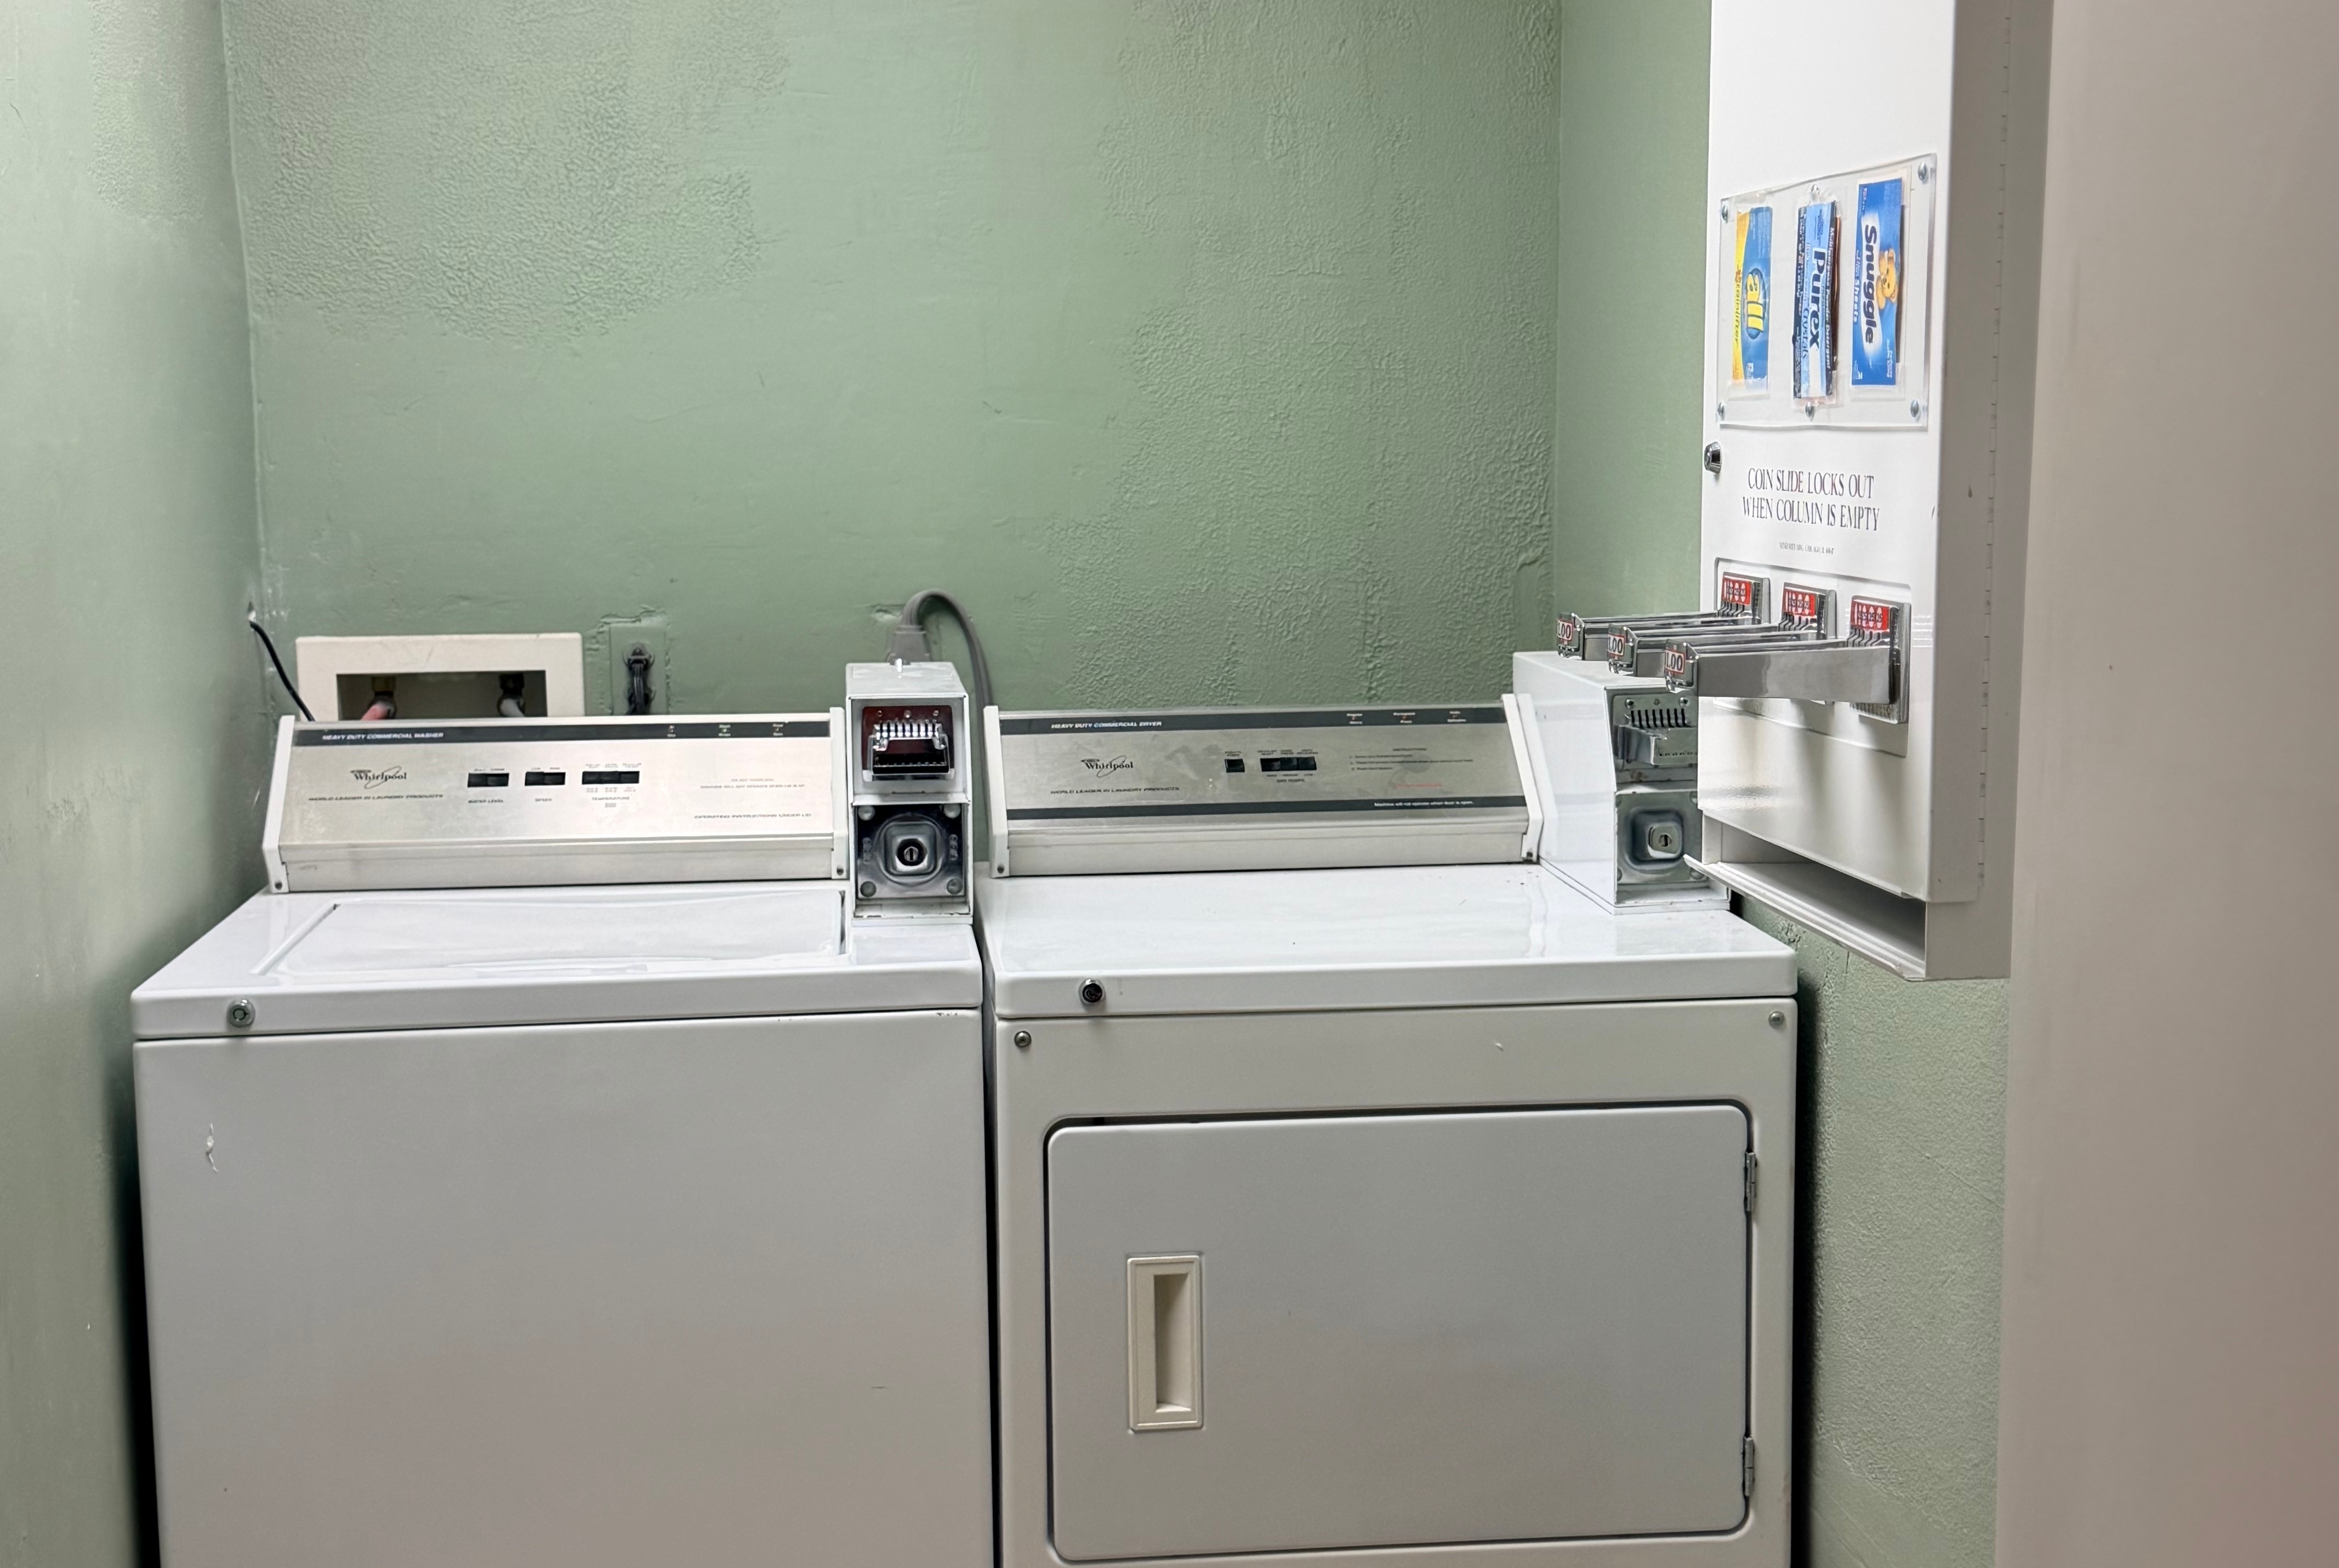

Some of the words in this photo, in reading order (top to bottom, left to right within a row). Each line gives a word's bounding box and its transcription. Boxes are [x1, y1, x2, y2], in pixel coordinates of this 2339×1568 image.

[1809, 250, 1825, 349] Purex
[1864, 225, 1877, 344] Snuggle
[1746, 273, 1764, 332] all
[1748, 467, 1773, 490] COIN
[1777, 470, 1803, 493] SLIDE
[1808, 472, 1844, 496] LOCKS
[1849, 475, 1874, 498] OUT
[1743, 497, 1773, 518] WHEN
[1777, 499, 1823, 526] COLUMN
[1827, 504, 1836, 527] IS
[1840, 505, 1880, 531] EMPTY
[351, 769, 407, 783] Whirlpool
[1081, 759, 1133, 771] Whirlpool
